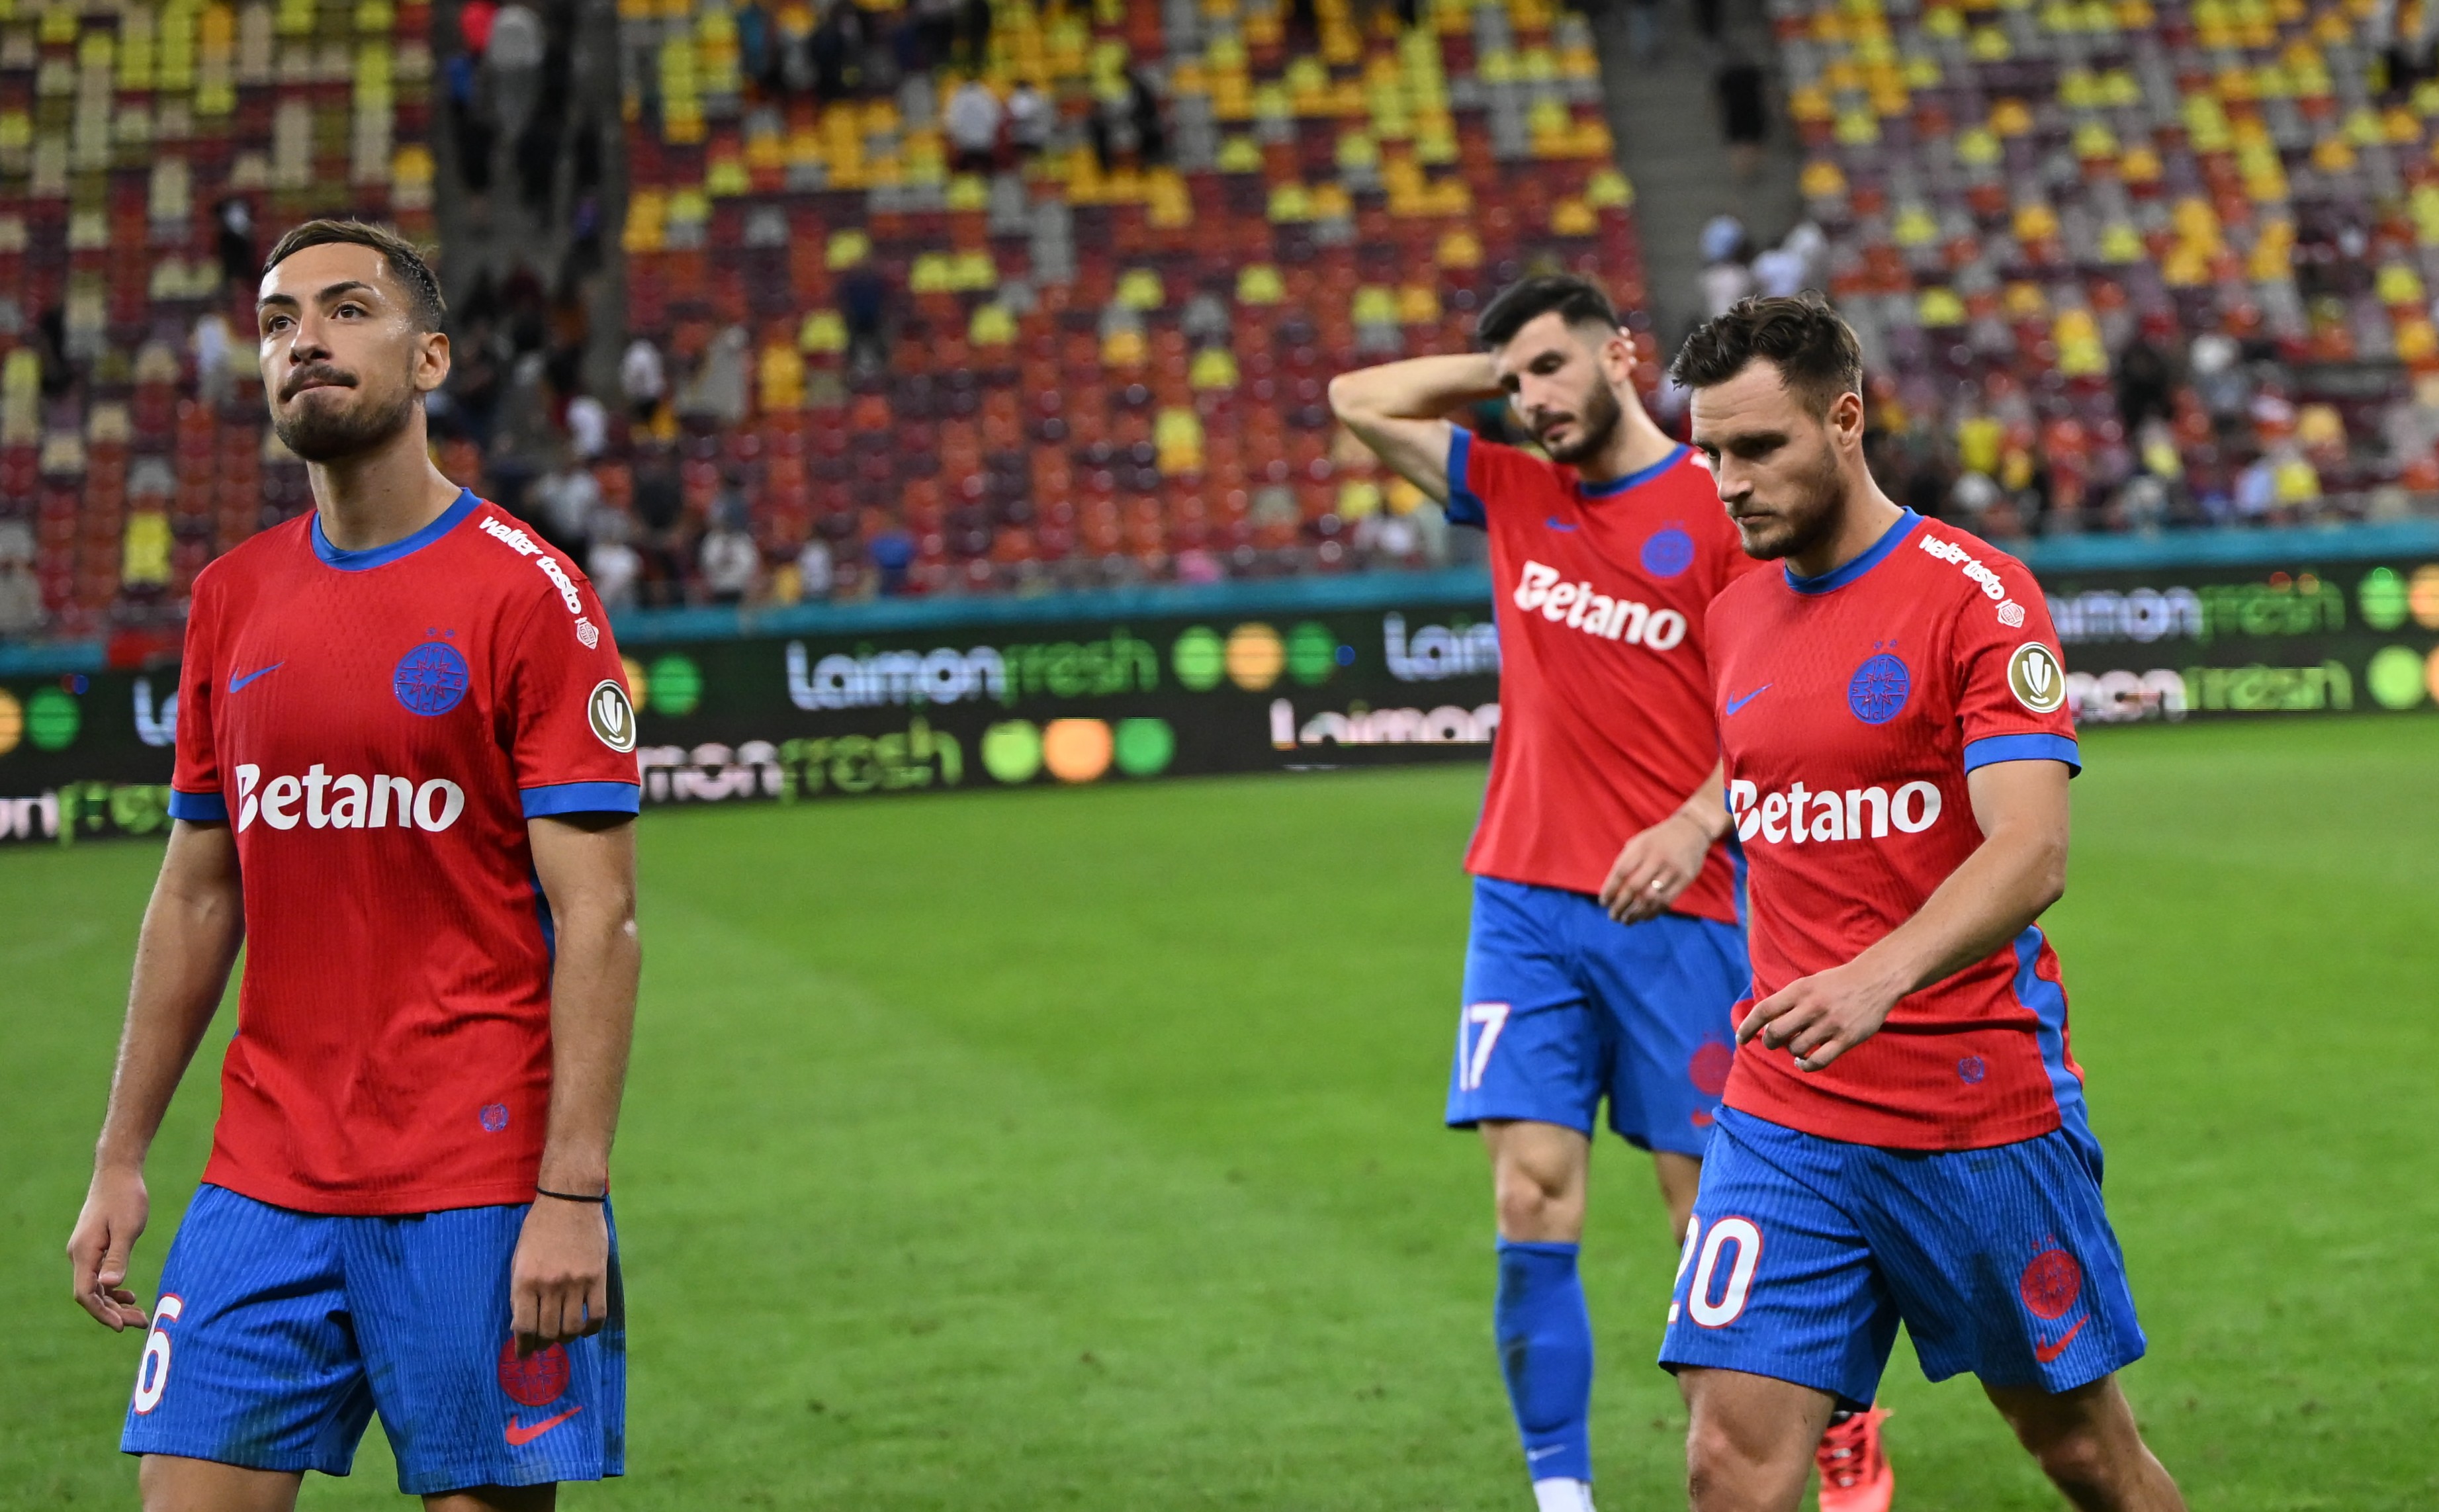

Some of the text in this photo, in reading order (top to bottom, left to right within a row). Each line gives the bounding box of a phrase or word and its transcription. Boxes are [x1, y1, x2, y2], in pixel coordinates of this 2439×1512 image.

[479, 516, 582, 614] walter tosto
[1513, 560, 1687, 651] Betano
[235, 763, 465, 834] Betano
[1729, 779, 1942, 844] Betano
[134, 1292, 185, 1416] 6
